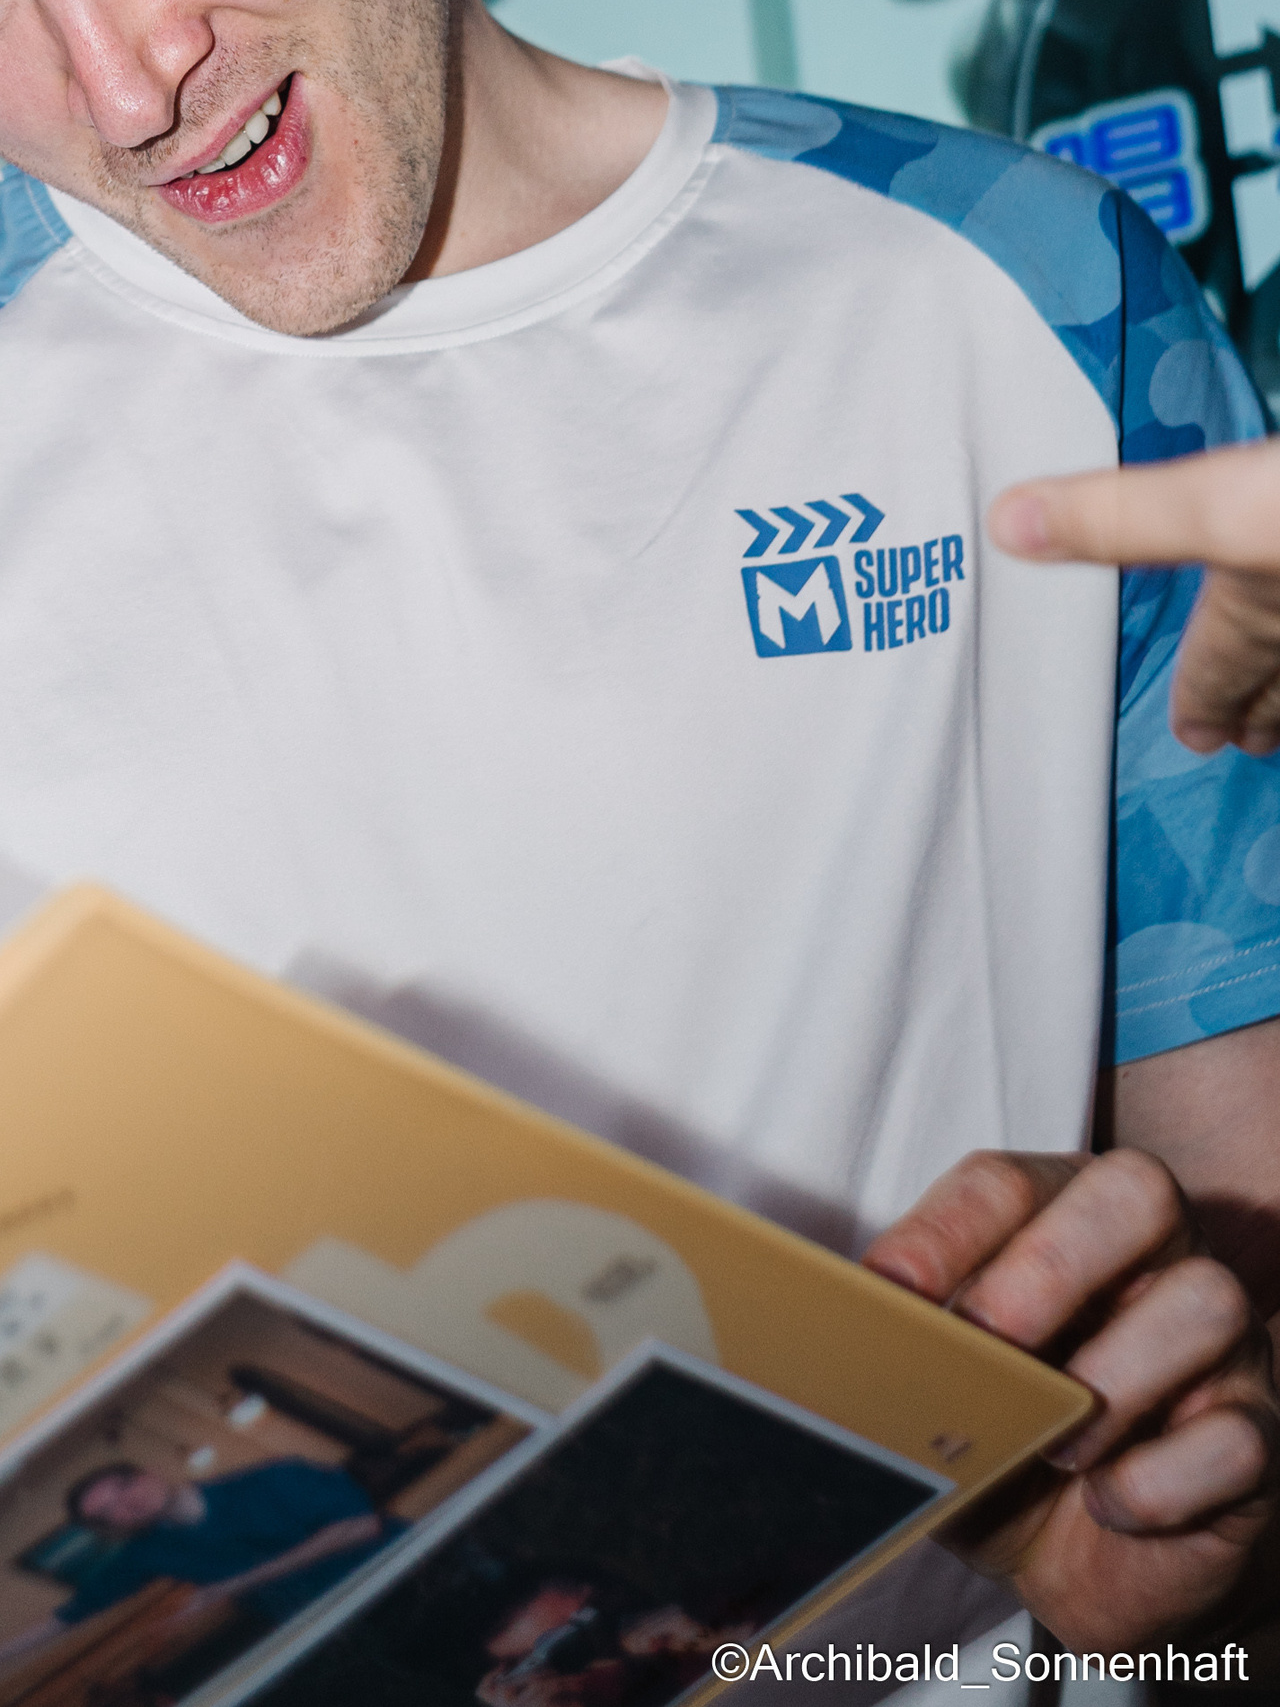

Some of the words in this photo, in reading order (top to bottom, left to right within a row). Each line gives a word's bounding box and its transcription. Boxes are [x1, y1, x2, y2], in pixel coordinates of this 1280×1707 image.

[854, 533, 966, 599] SUPER
[754, 558, 843, 650] M
[863, 587, 950, 652] HERO
